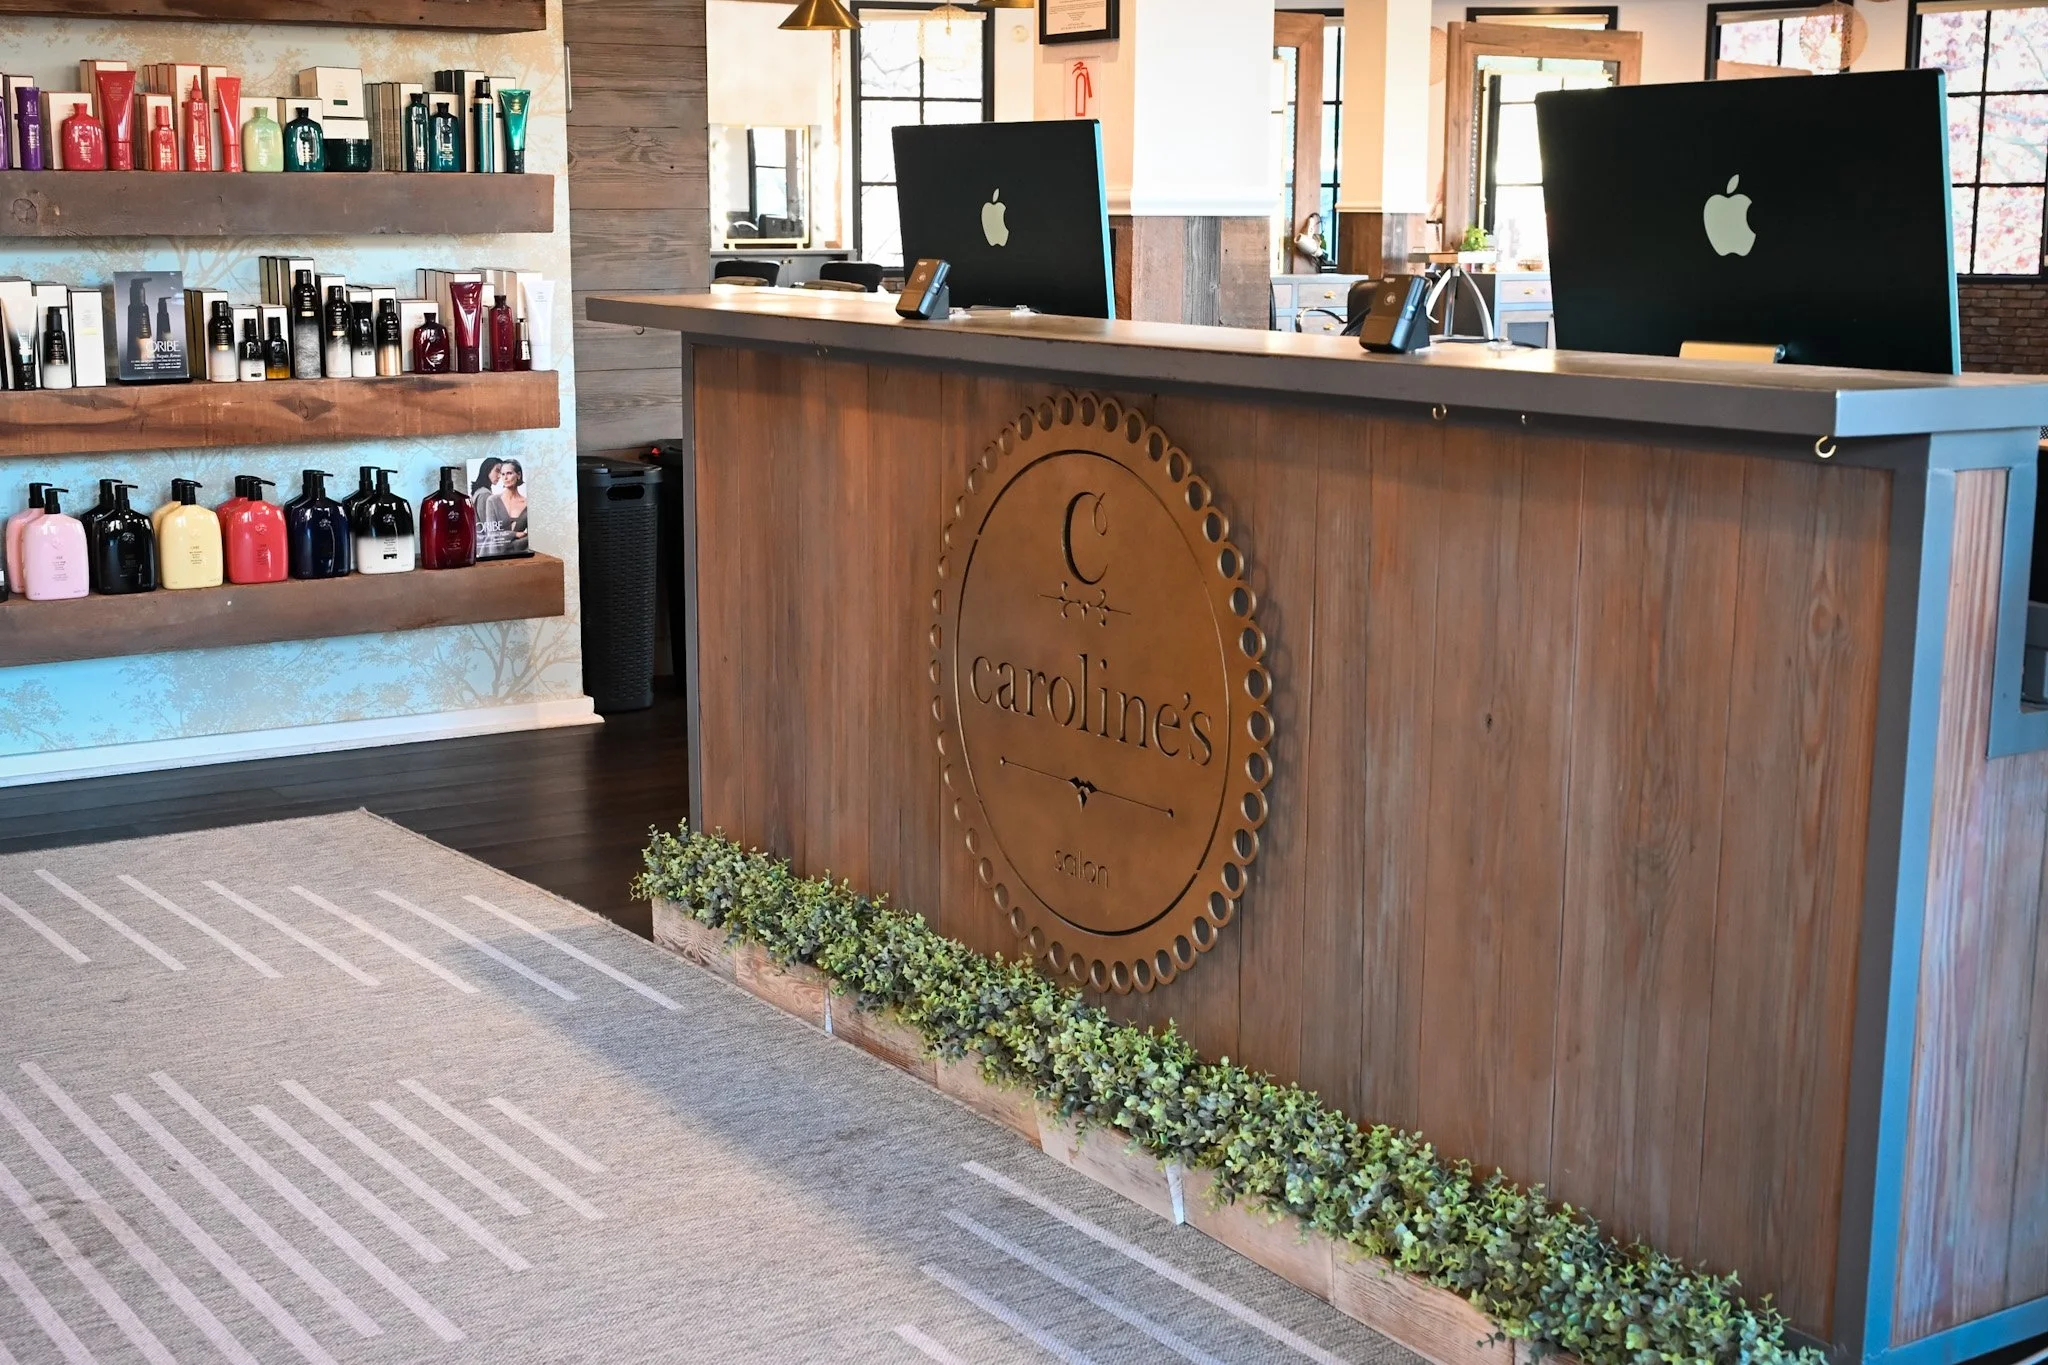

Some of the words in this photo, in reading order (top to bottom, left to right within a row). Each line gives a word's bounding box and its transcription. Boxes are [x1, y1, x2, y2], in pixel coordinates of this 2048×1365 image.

[146, 340, 181, 352] ORIBE
[476, 520, 504, 533] ORIBE
[970, 653, 1212, 766] caroline's
[1054, 849, 1108, 889] salon
